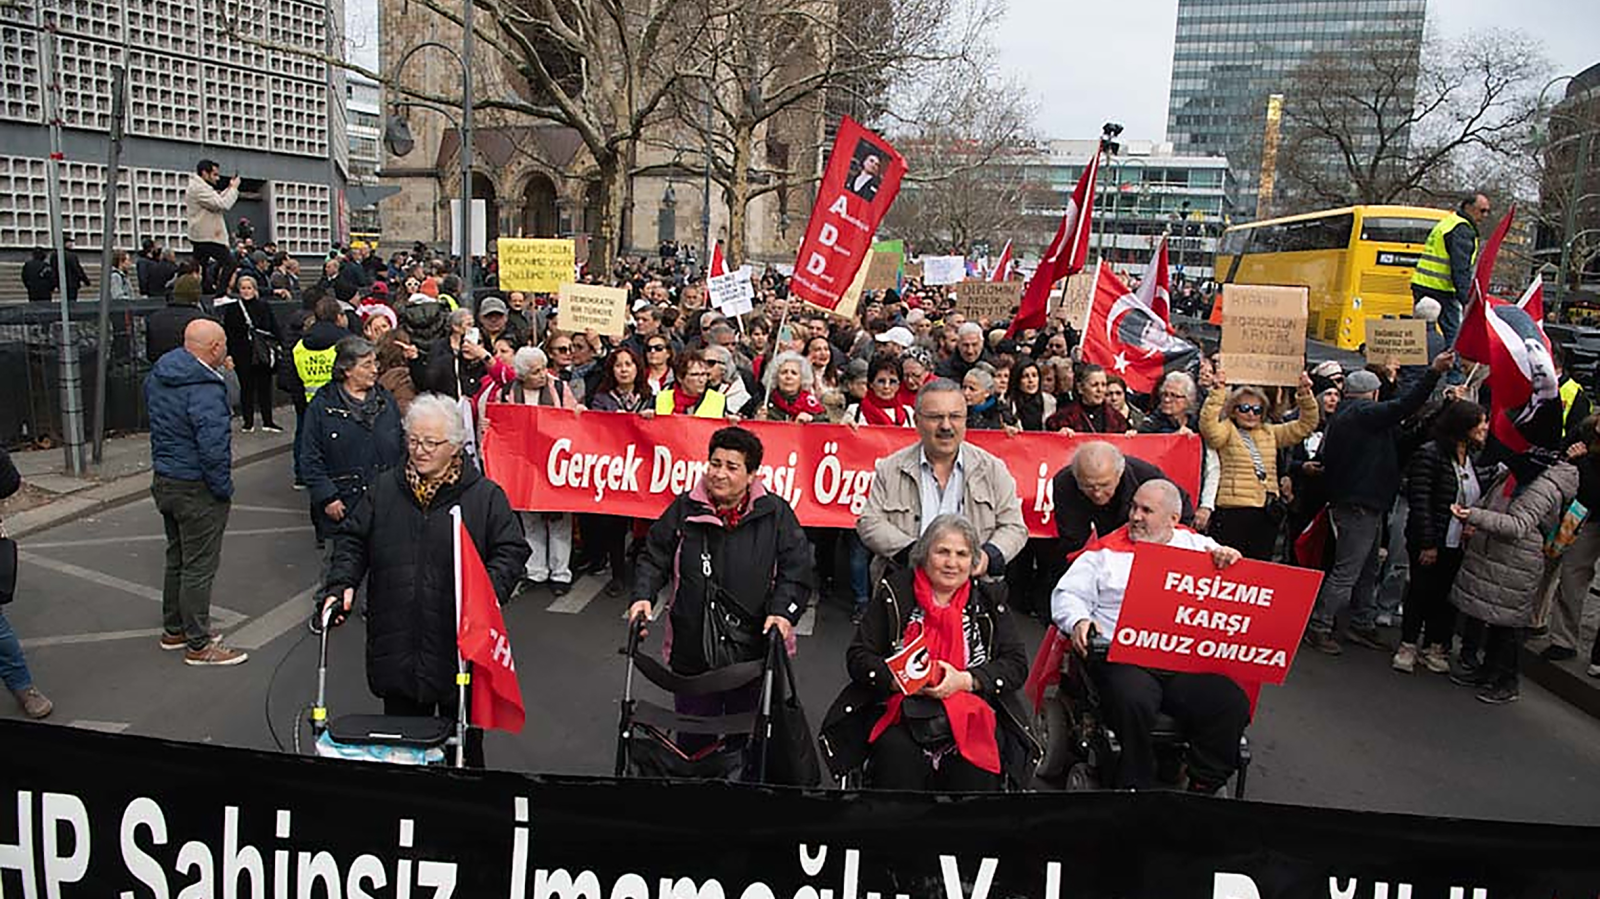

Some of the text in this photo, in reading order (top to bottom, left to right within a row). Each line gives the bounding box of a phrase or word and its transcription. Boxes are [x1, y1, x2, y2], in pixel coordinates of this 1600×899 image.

[547, 438, 643, 503] Gerçek
[649, 445, 801, 510] Demasi,
[1163, 571, 1274, 607] FAŞİZME
[1174, 605, 1250, 636] KARŞI
[1116, 627, 1287, 667] OMUZ OMUZA
